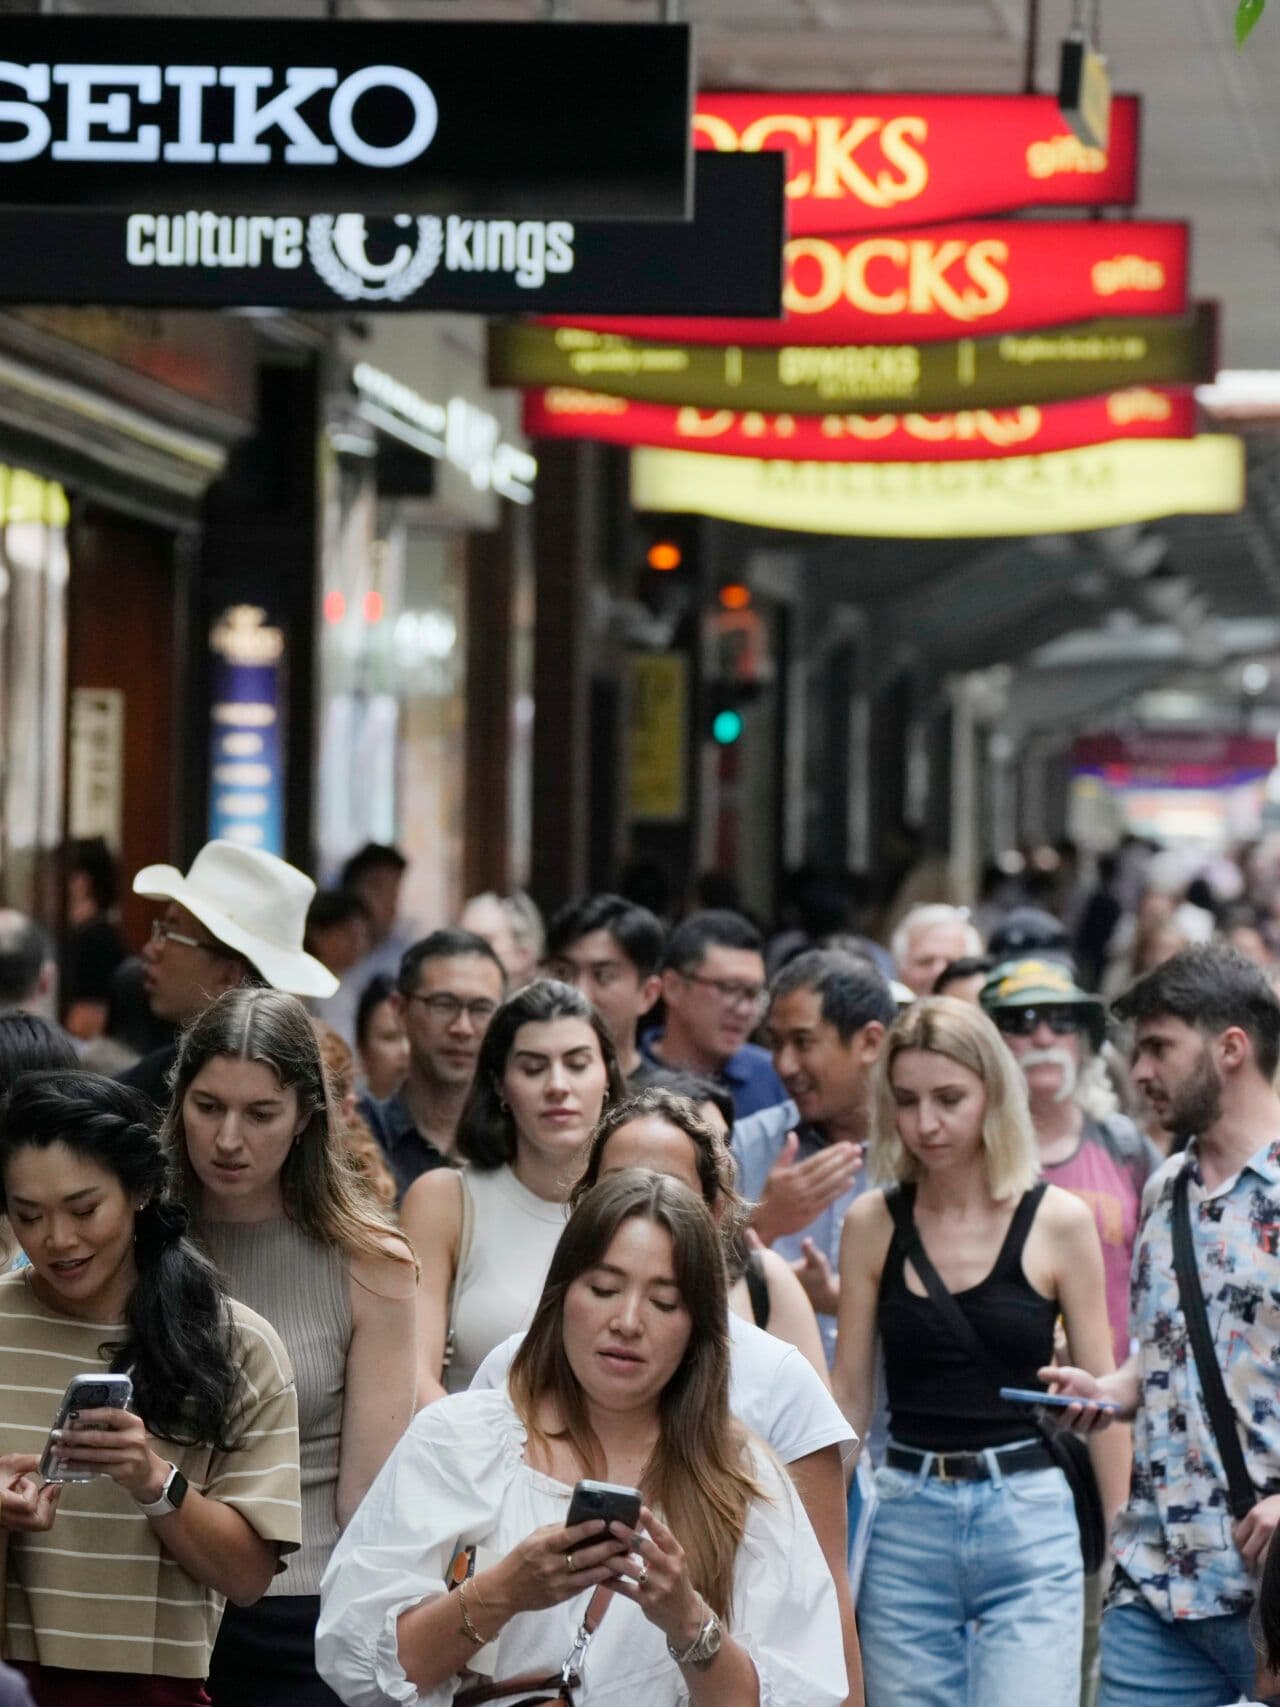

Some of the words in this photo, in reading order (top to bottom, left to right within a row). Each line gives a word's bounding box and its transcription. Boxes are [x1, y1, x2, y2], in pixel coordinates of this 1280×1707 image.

[126, 210, 303, 269] culture
[446, 214, 575, 288] kings
[1091, 255, 1166, 296] gifts
